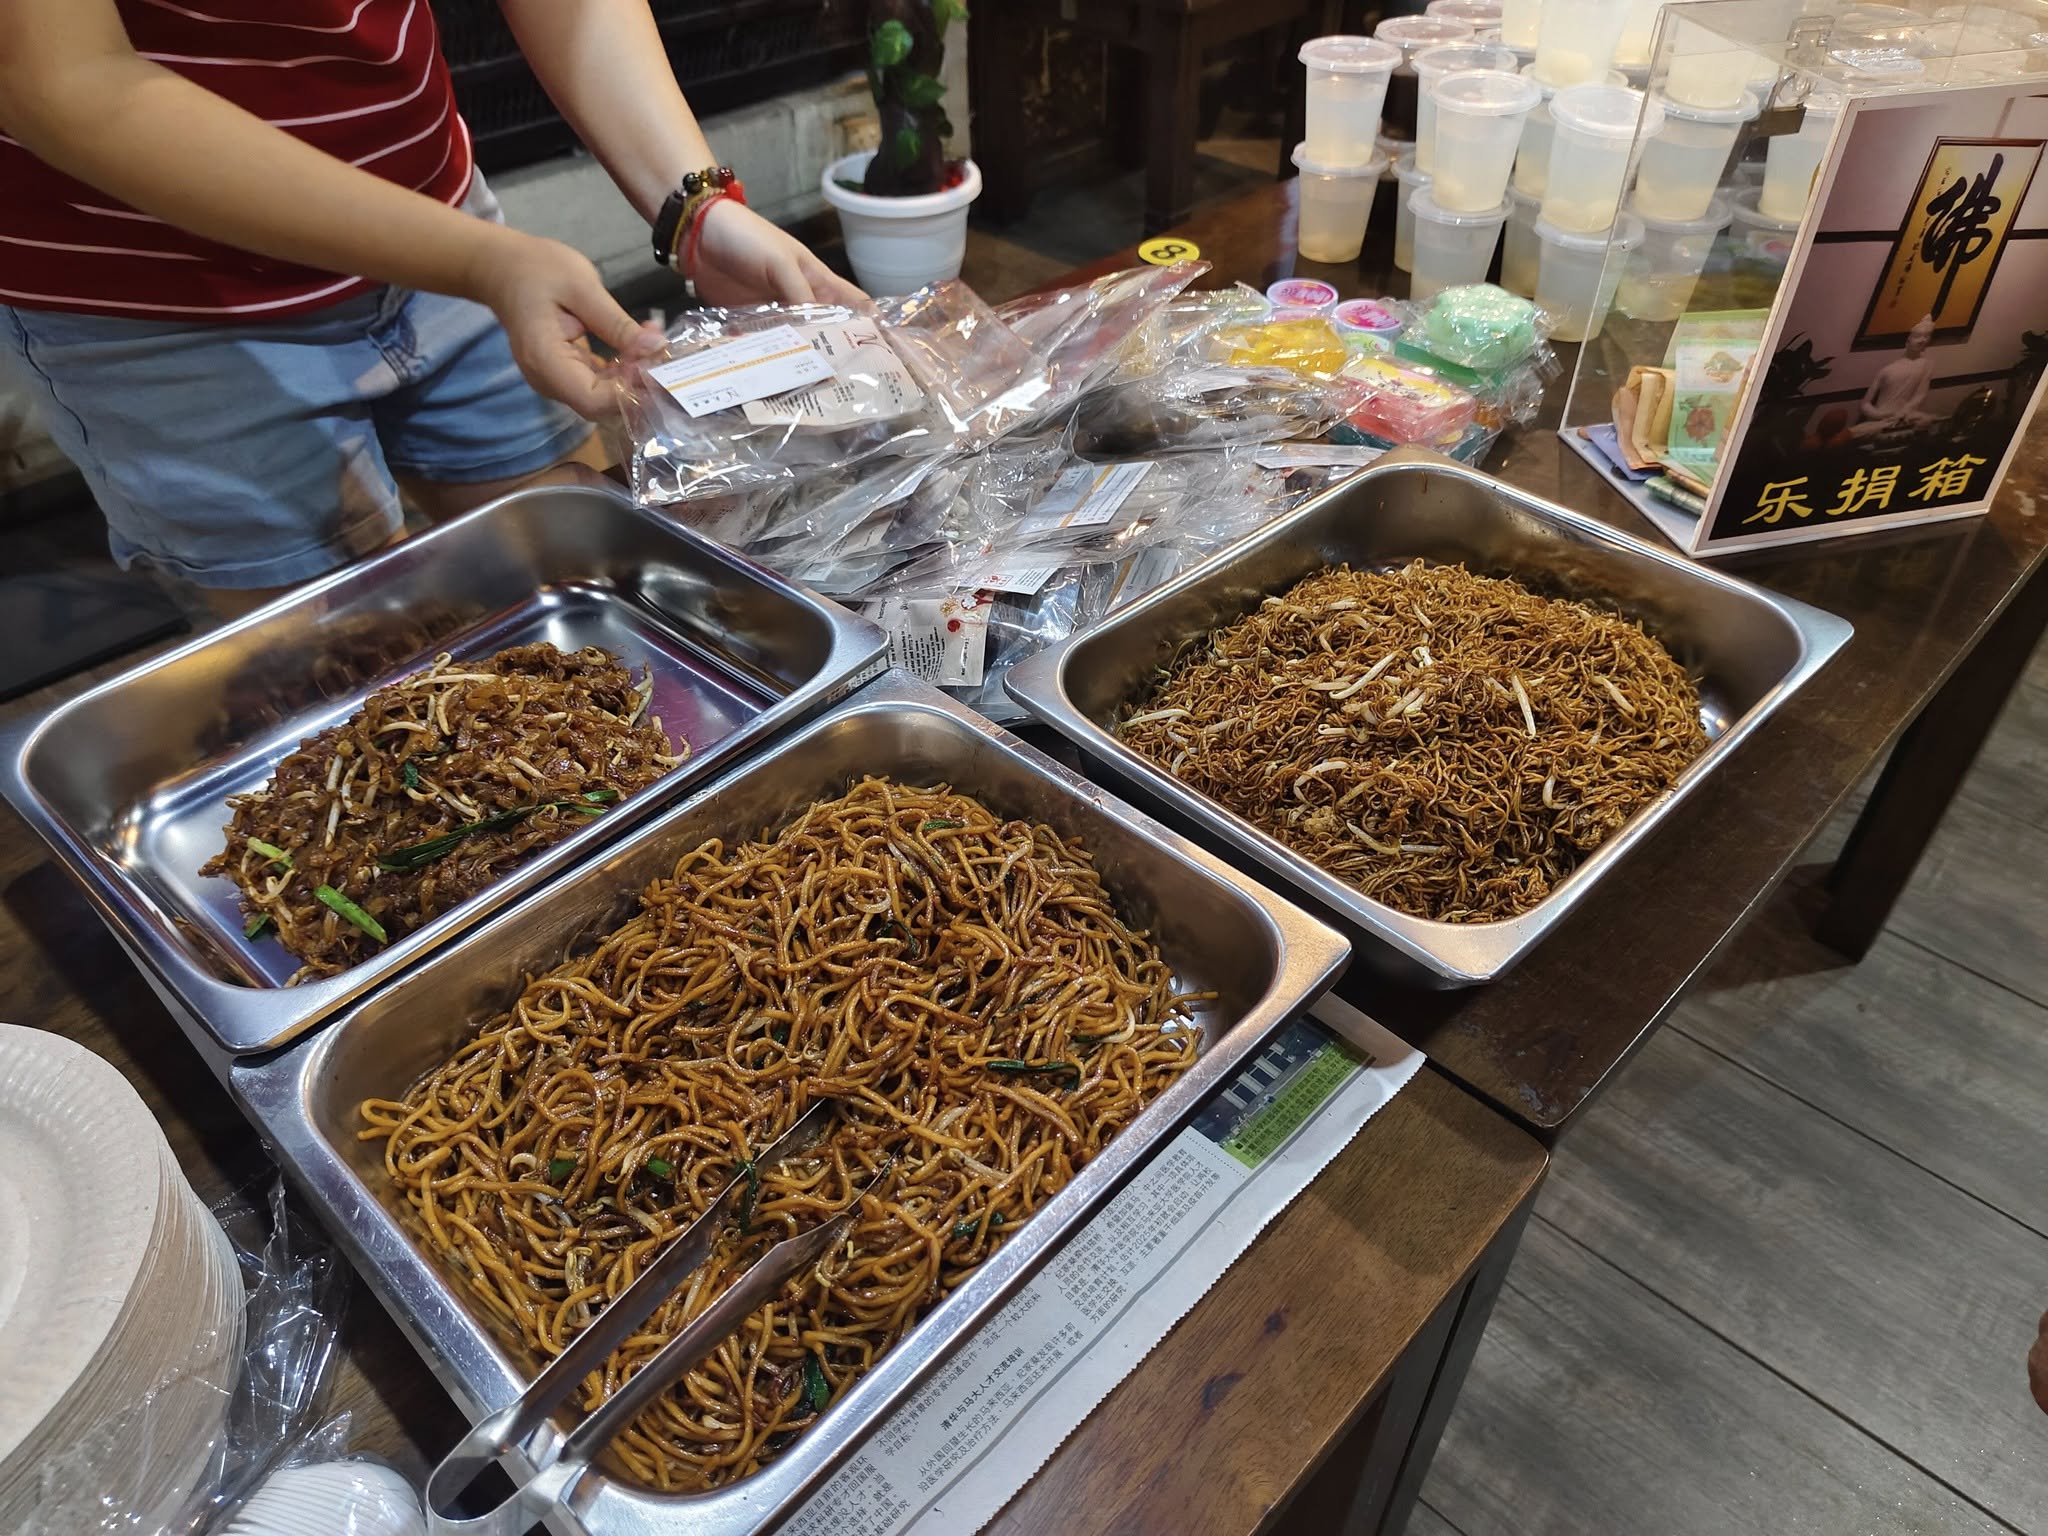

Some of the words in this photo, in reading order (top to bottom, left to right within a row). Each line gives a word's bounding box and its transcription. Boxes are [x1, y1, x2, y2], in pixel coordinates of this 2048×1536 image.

[1741, 453, 1987, 524] 乐捐箱
[938, 1345, 1025, 1432] 清华与马大人才交流培训
